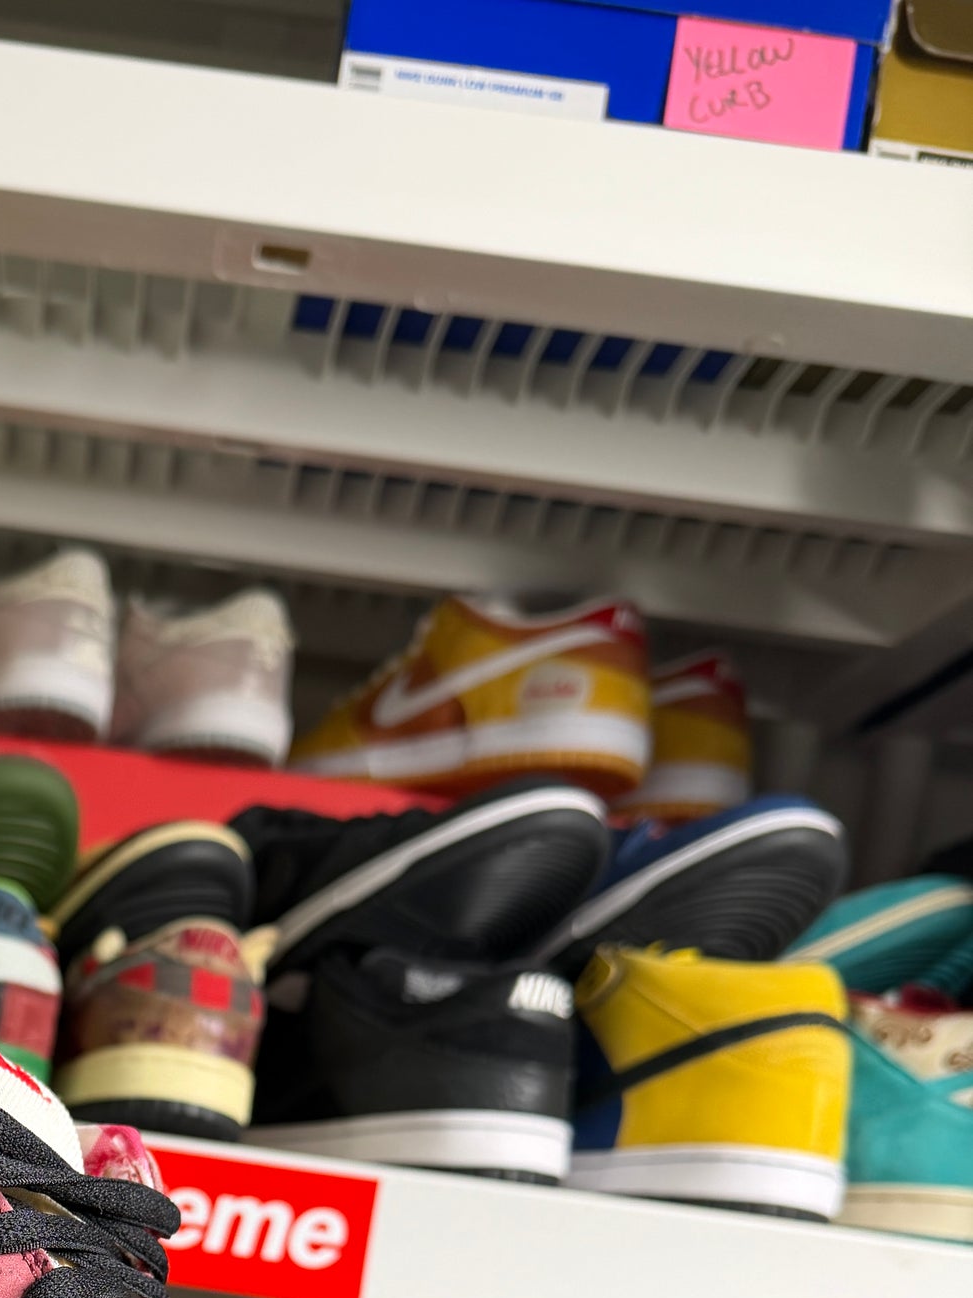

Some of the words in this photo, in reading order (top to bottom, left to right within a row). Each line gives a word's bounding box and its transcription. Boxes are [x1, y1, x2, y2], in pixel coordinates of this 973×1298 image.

[684, 37, 794, 84] YELLOW
[689, 80, 771, 123] CURB
[507, 971, 574, 1020] NIKE
